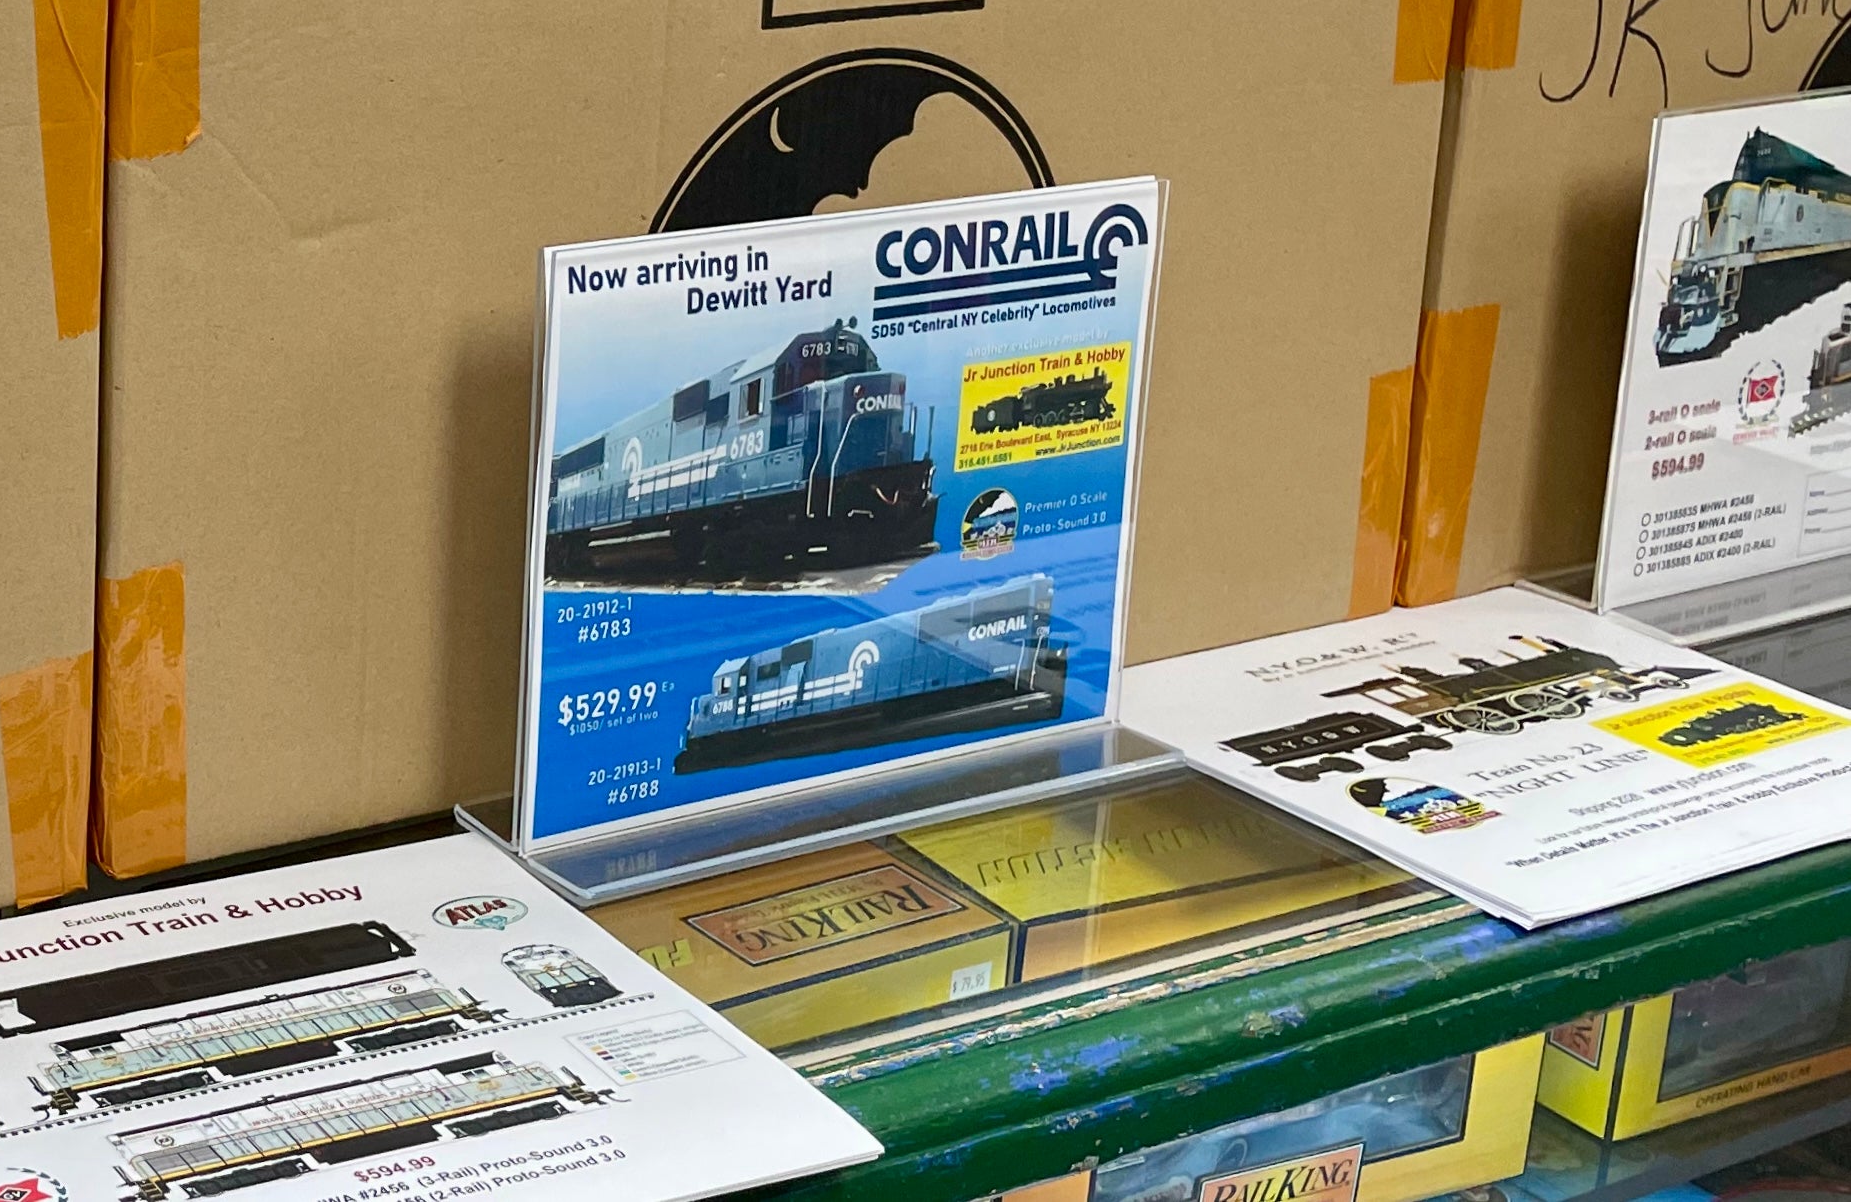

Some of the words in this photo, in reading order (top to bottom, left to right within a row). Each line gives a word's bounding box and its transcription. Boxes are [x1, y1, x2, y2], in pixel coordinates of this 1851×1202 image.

[875, 212, 1078, 279] CONRAIL
[567, 265, 628, 295] Now
[636, 252, 739, 288] arriving
[746, 247, 770, 272] in
[687, 282, 769, 316] Dewitt
[776, 272, 832, 301] Yard
[871, 322, 905, 339] SD50
[962, 311, 979, 326] NY
[1043, 296, 1116, 316] Locomotives
[802, 342, 832, 358] 6783
[964, 369, 976, 383] Jr
[981, 361, 1035, 380] Junction
[1040, 358, 1070, 375] Train
[1075, 352, 1083, 365] &
[1087, 348, 1125, 366] Hobby
[730, 430, 765, 460] 6783
[995, 434, 1033, 450] Boulevard
[1056, 427, 1089, 441] Syracuse
[1652, 452, 1705, 480] $594.99
[1025, 499, 1066, 513] Premier
[1080, 491, 1108, 505] Scale
[1022, 514, 1089, 536] Proto-Sound
[558, 597, 632, 624] 20-21912-1
[578, 618, 631, 643] #6783
[968, 615, 1027, 641] CONRAIL
[558, 682, 657, 727] $529.99
[626, 713, 637, 724] of
[639, 710, 659, 721] two
[588, 758, 661, 786] 20-21913-1
[1467, 765, 1531, 785] Train
[608, 780, 659, 805] #6788
[63, 907, 136, 928] Exclusive
[139, 899, 185, 915] model
[187, 896, 208, 908] by
[127, 910, 219, 936] Train
[225, 903, 253, 920] &
[255, 885, 364, 913] Hobby
[445, 898, 508, 926] ATLAS
[736, 885, 934, 952] RAILKING
[1754, 1072, 1787, 1093] HAND
[354, 1155, 436, 1183] $594.99
[359, 1180, 411, 1201] #2456
[417, 1165, 479, 1189] (3-Rail)
[482, 1140, 586, 1174] Proto-Sound
[588, 1135, 614, 1149] 3.0
[494, 1156, 600, 1189] Proto-Sound
[602, 1149, 627, 1165] 3.0
